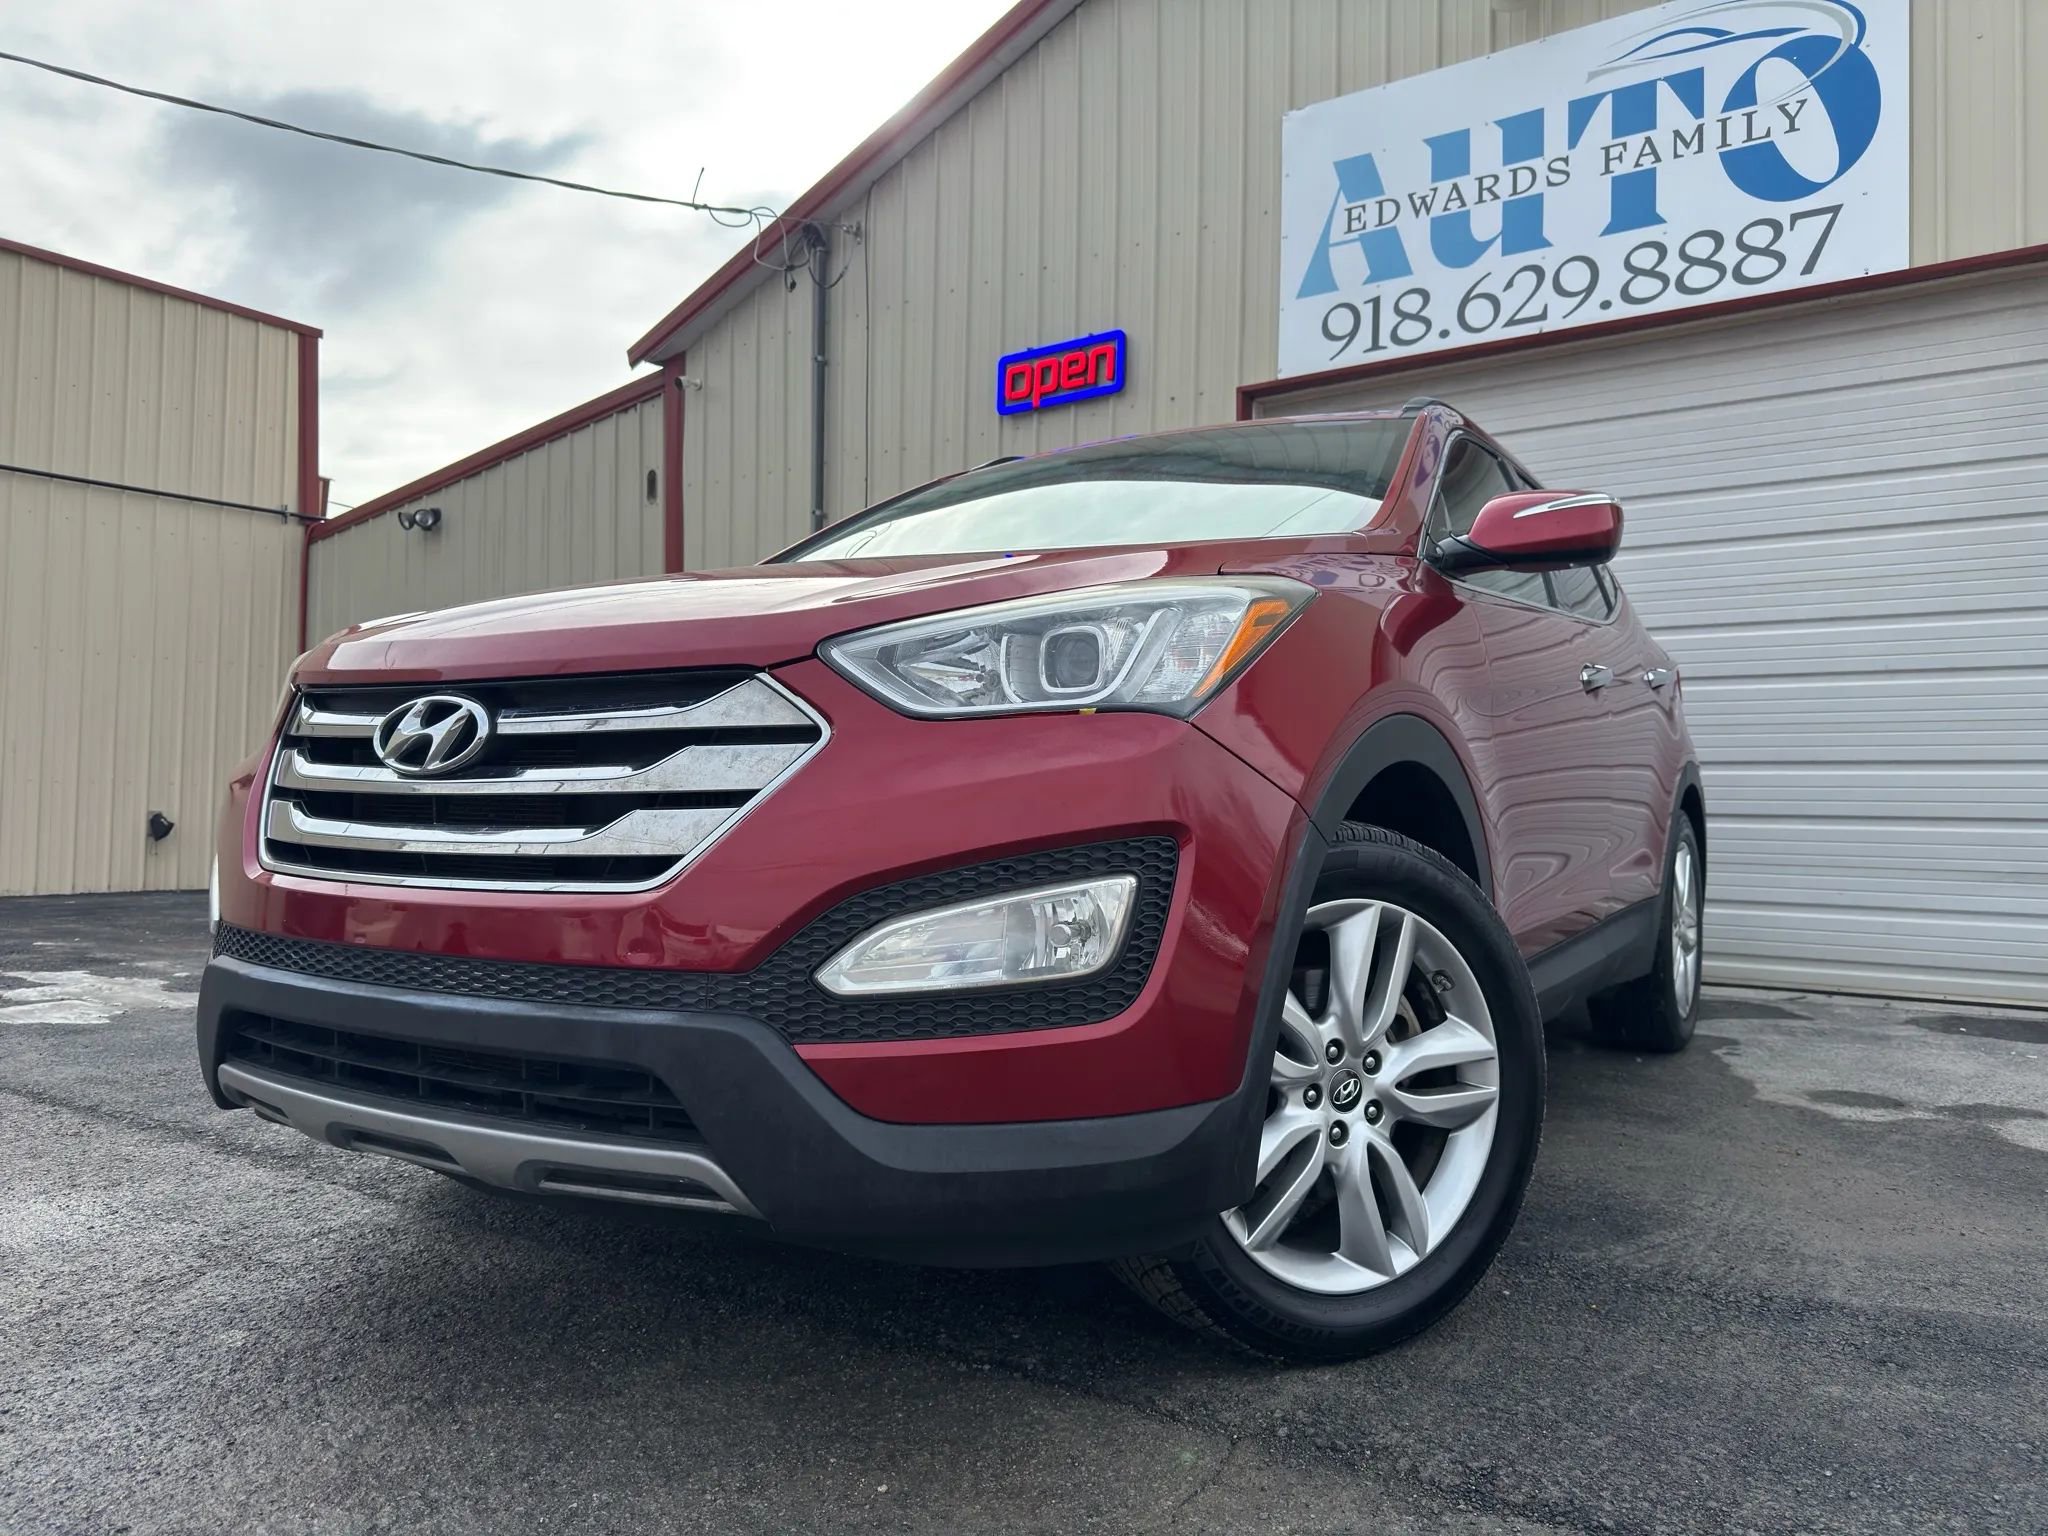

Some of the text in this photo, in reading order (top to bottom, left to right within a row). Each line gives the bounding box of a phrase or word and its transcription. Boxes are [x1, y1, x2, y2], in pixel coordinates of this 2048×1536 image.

[1296, 35, 1882, 300] AUTO
[1343, 97, 1809, 235] EDWARDS FAMILY
[1320, 203, 1844, 361] 918.629.8887
[1004, 344, 1116, 408] open
